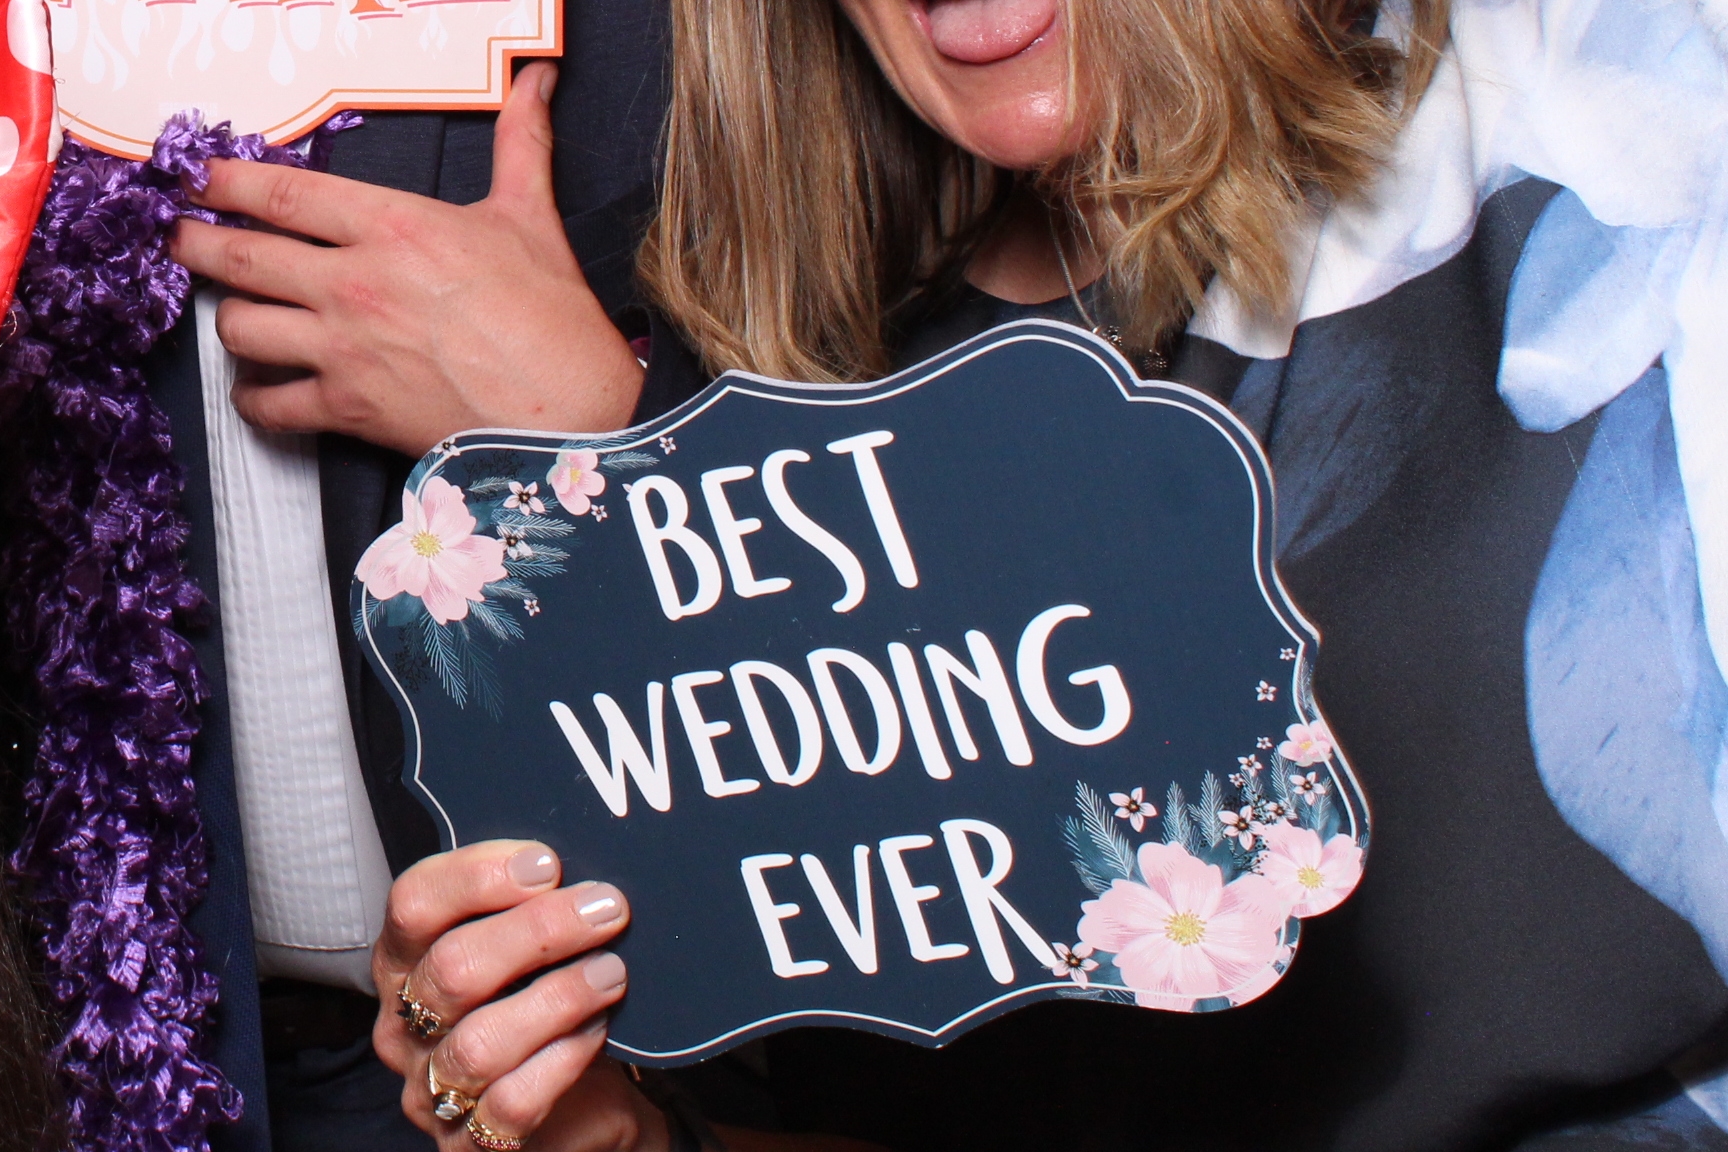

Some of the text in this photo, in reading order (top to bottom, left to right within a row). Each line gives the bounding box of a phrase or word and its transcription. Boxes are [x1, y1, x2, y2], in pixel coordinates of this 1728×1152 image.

[627, 430, 919, 621] BEST
[549, 603, 1132, 817] WEDDING
[740, 819, 1061, 984] EVER
